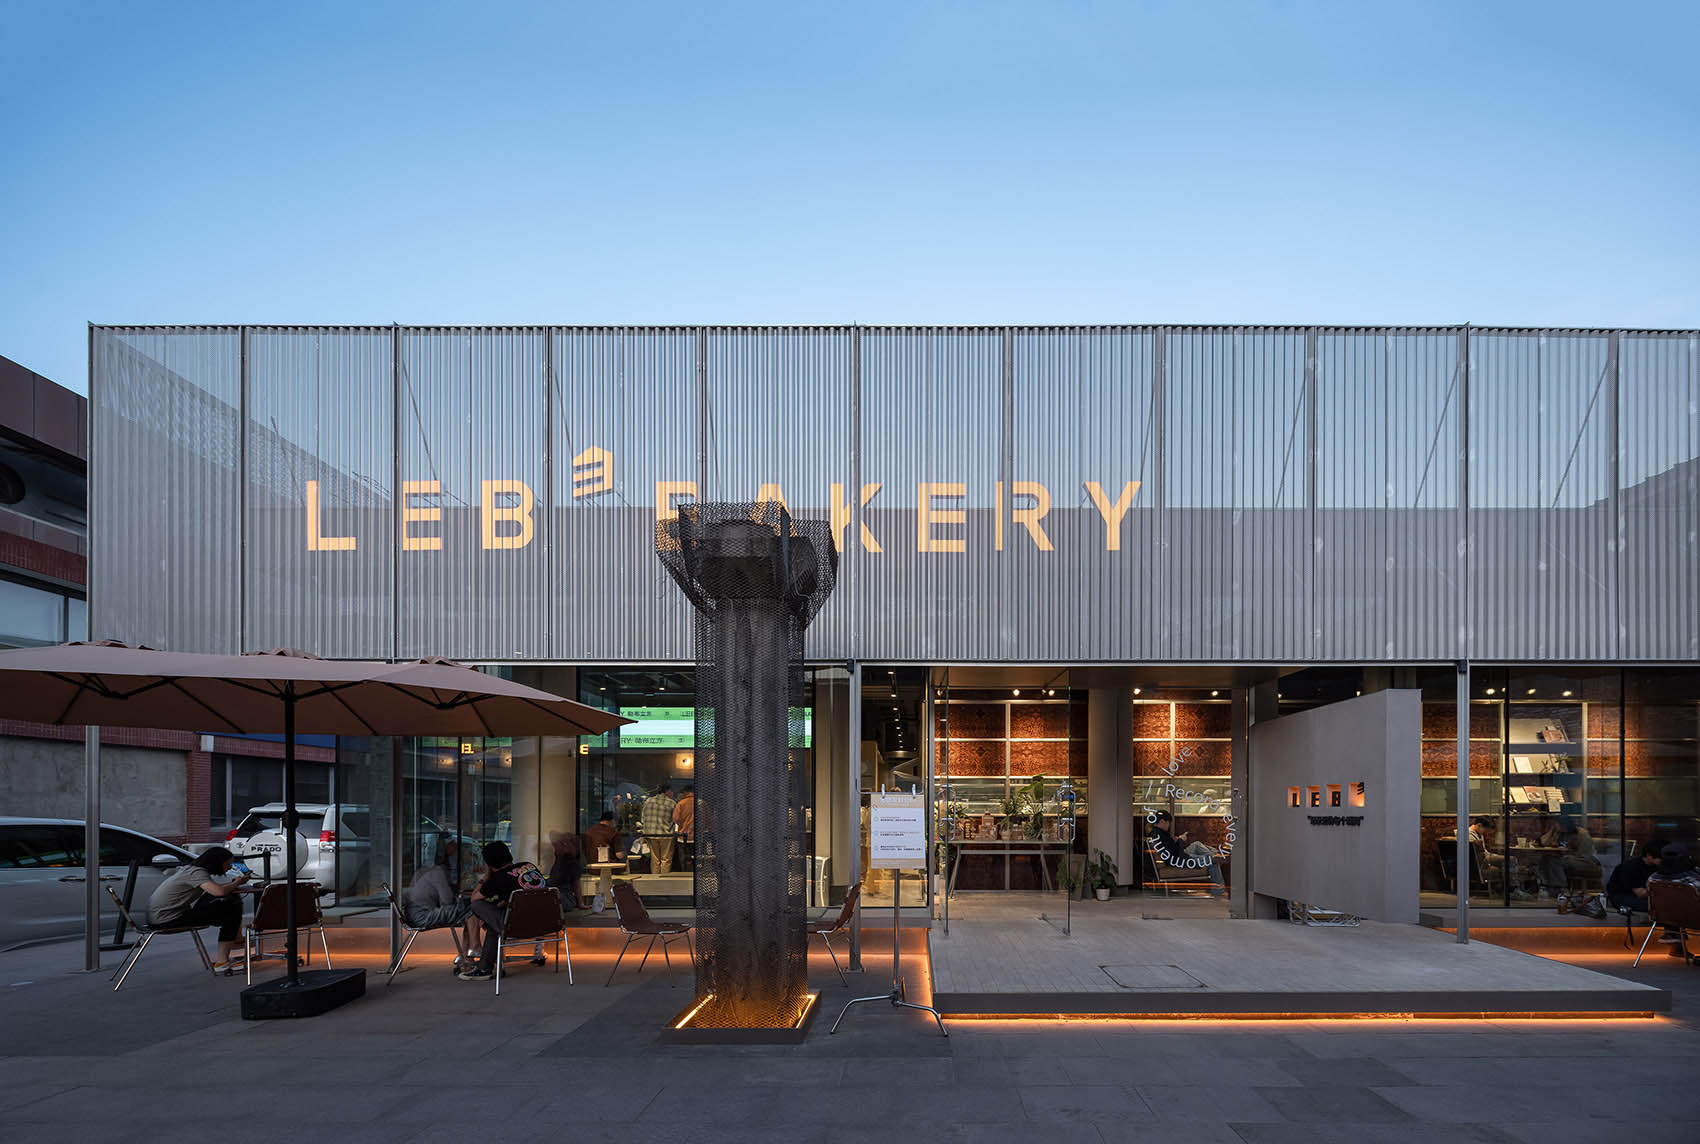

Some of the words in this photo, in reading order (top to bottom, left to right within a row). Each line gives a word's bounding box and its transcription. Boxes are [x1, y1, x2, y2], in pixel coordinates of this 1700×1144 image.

[306, 480, 534, 551] LEB
[1161, 746, 1193, 776] love
[1165, 783, 1222, 811] Record
[1143, 805, 1159, 824] of
[1148, 834, 1213, 869] moment
[1217, 814, 1237, 859] every
